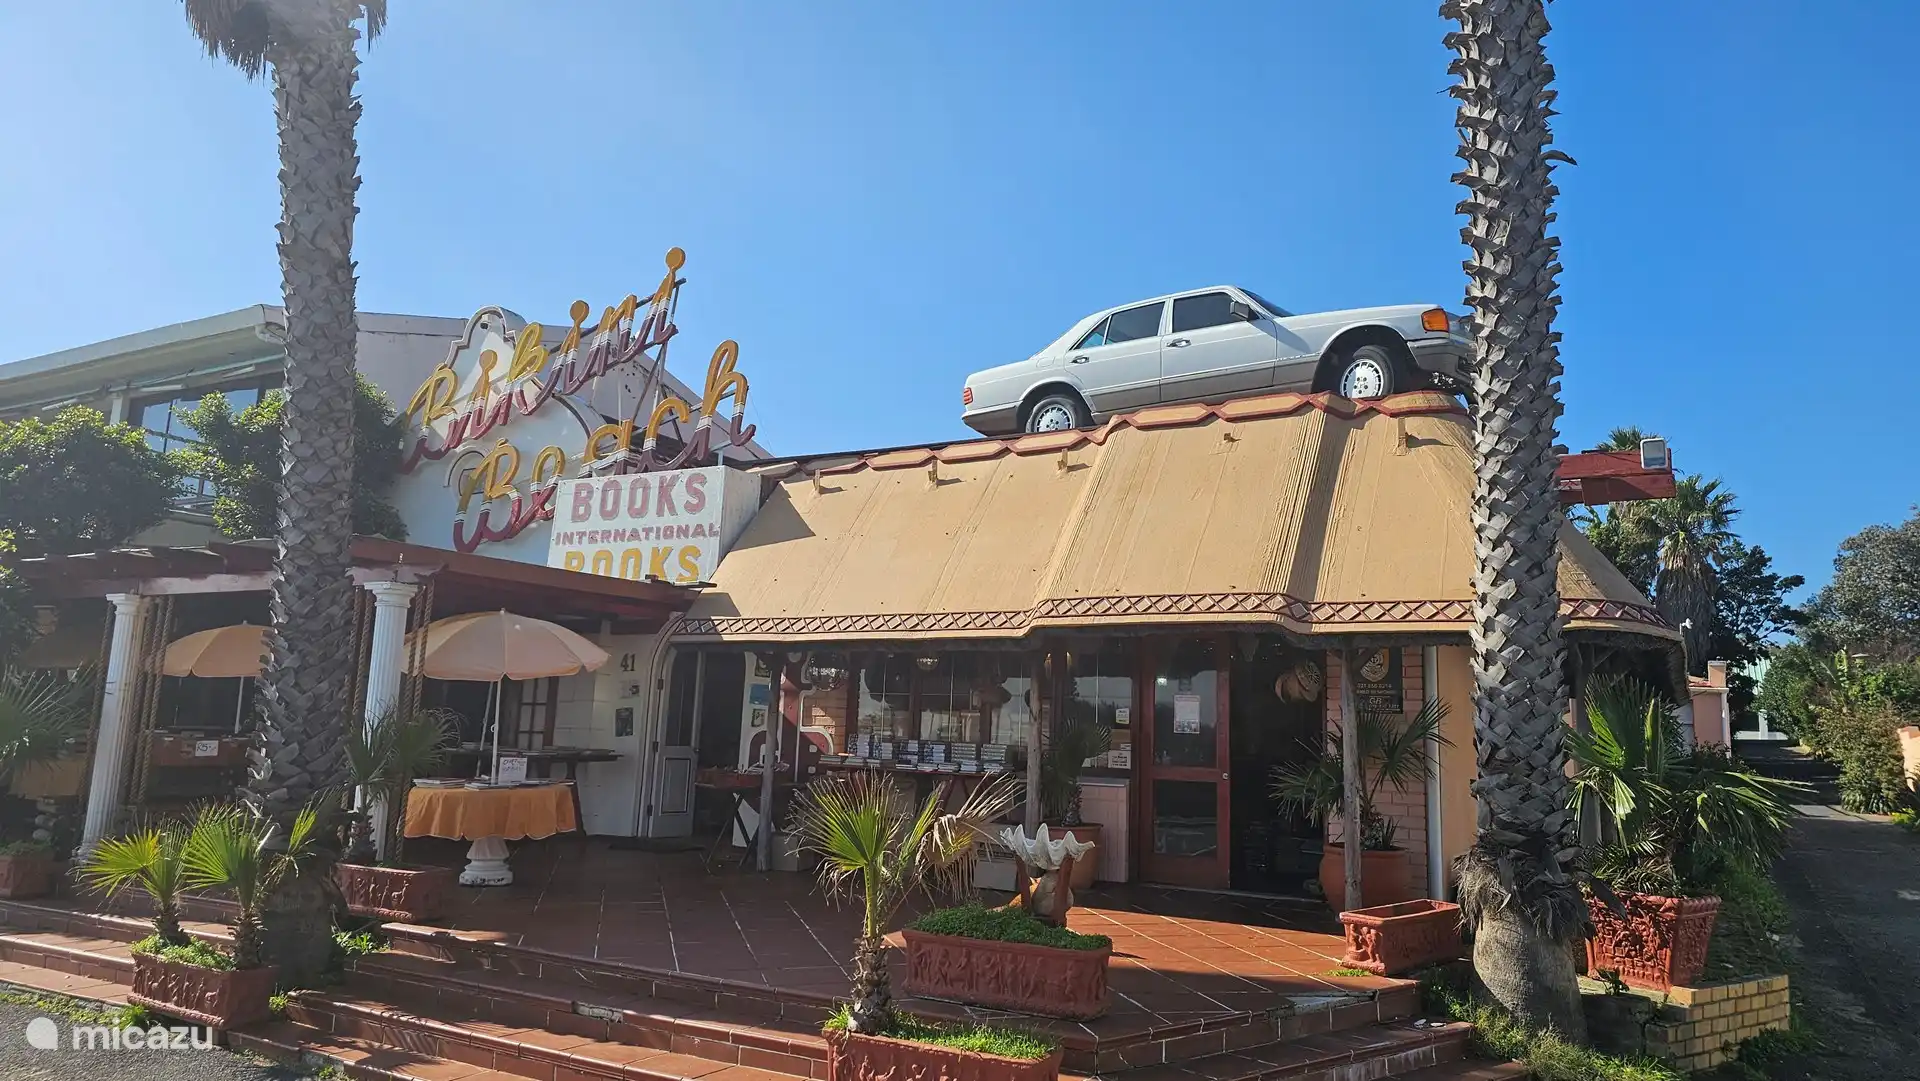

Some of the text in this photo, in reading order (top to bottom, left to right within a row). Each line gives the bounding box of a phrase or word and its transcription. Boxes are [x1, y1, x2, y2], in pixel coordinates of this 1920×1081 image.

[453, 340, 756, 552] Beach
[571, 472, 708, 523] BOOKS
[555, 522, 720, 546] INTERNATIONAL
[620, 653, 636, 672] 41
